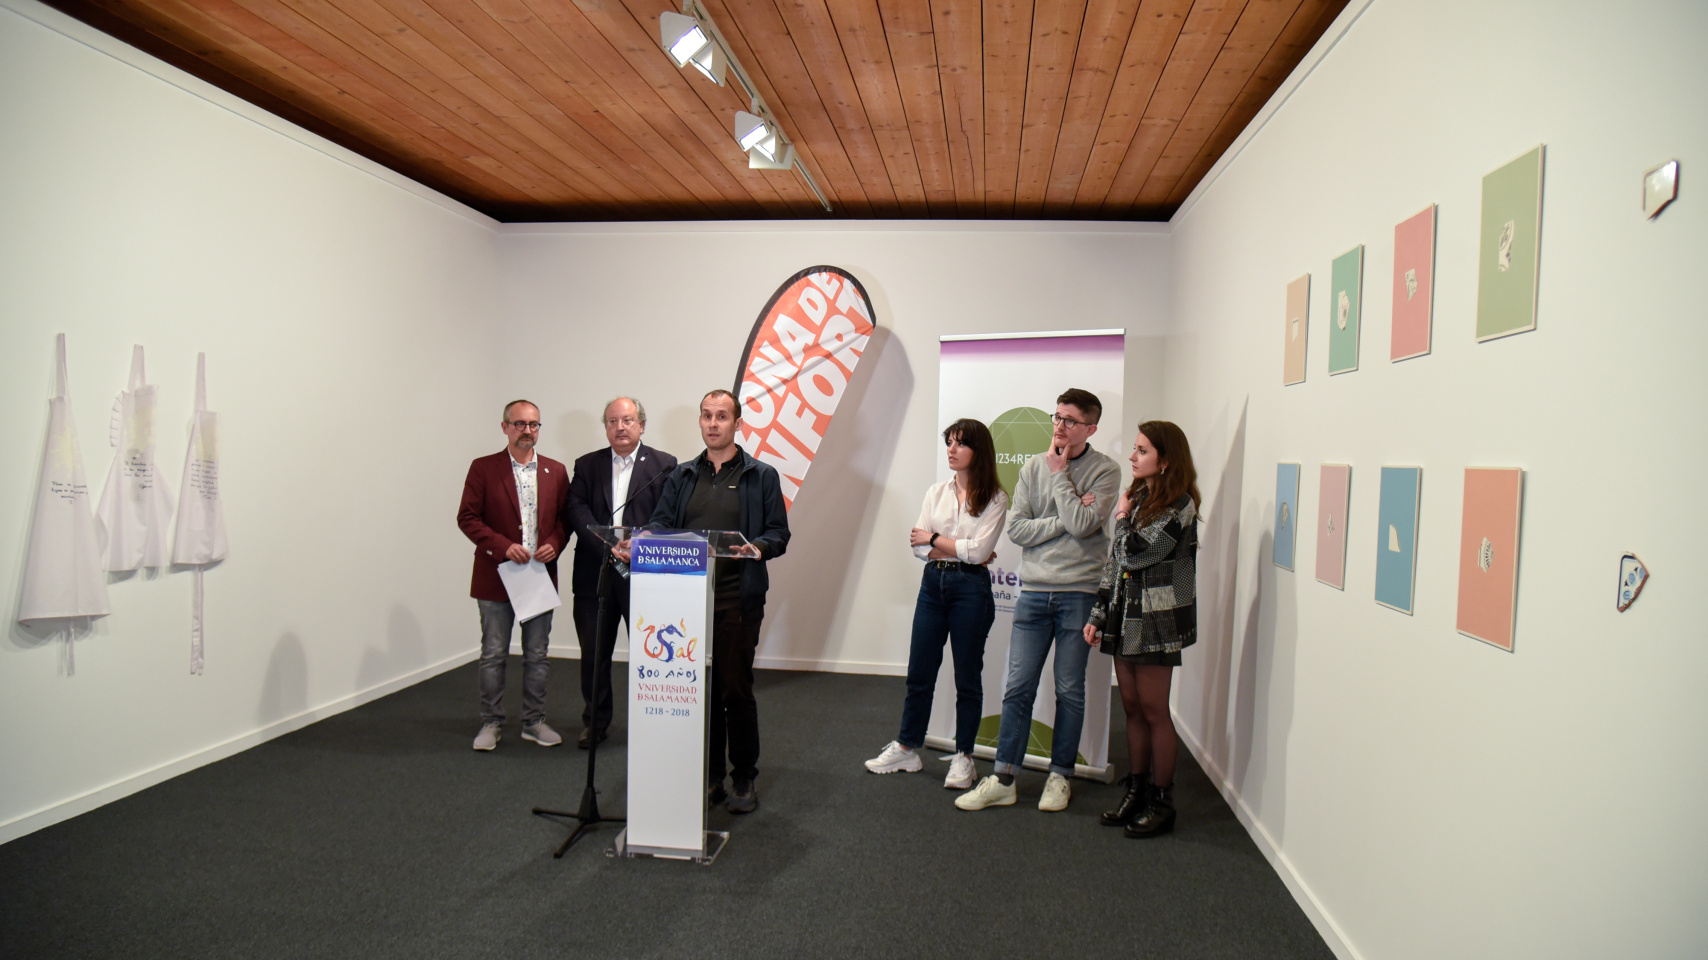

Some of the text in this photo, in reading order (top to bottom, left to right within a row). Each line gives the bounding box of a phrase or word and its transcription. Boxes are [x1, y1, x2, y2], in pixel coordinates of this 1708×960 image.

[758, 278, 873, 502] NFORT
[993, 591, 1011, 600] aña
[637, 665, 697, 683] 800 AÑOS
